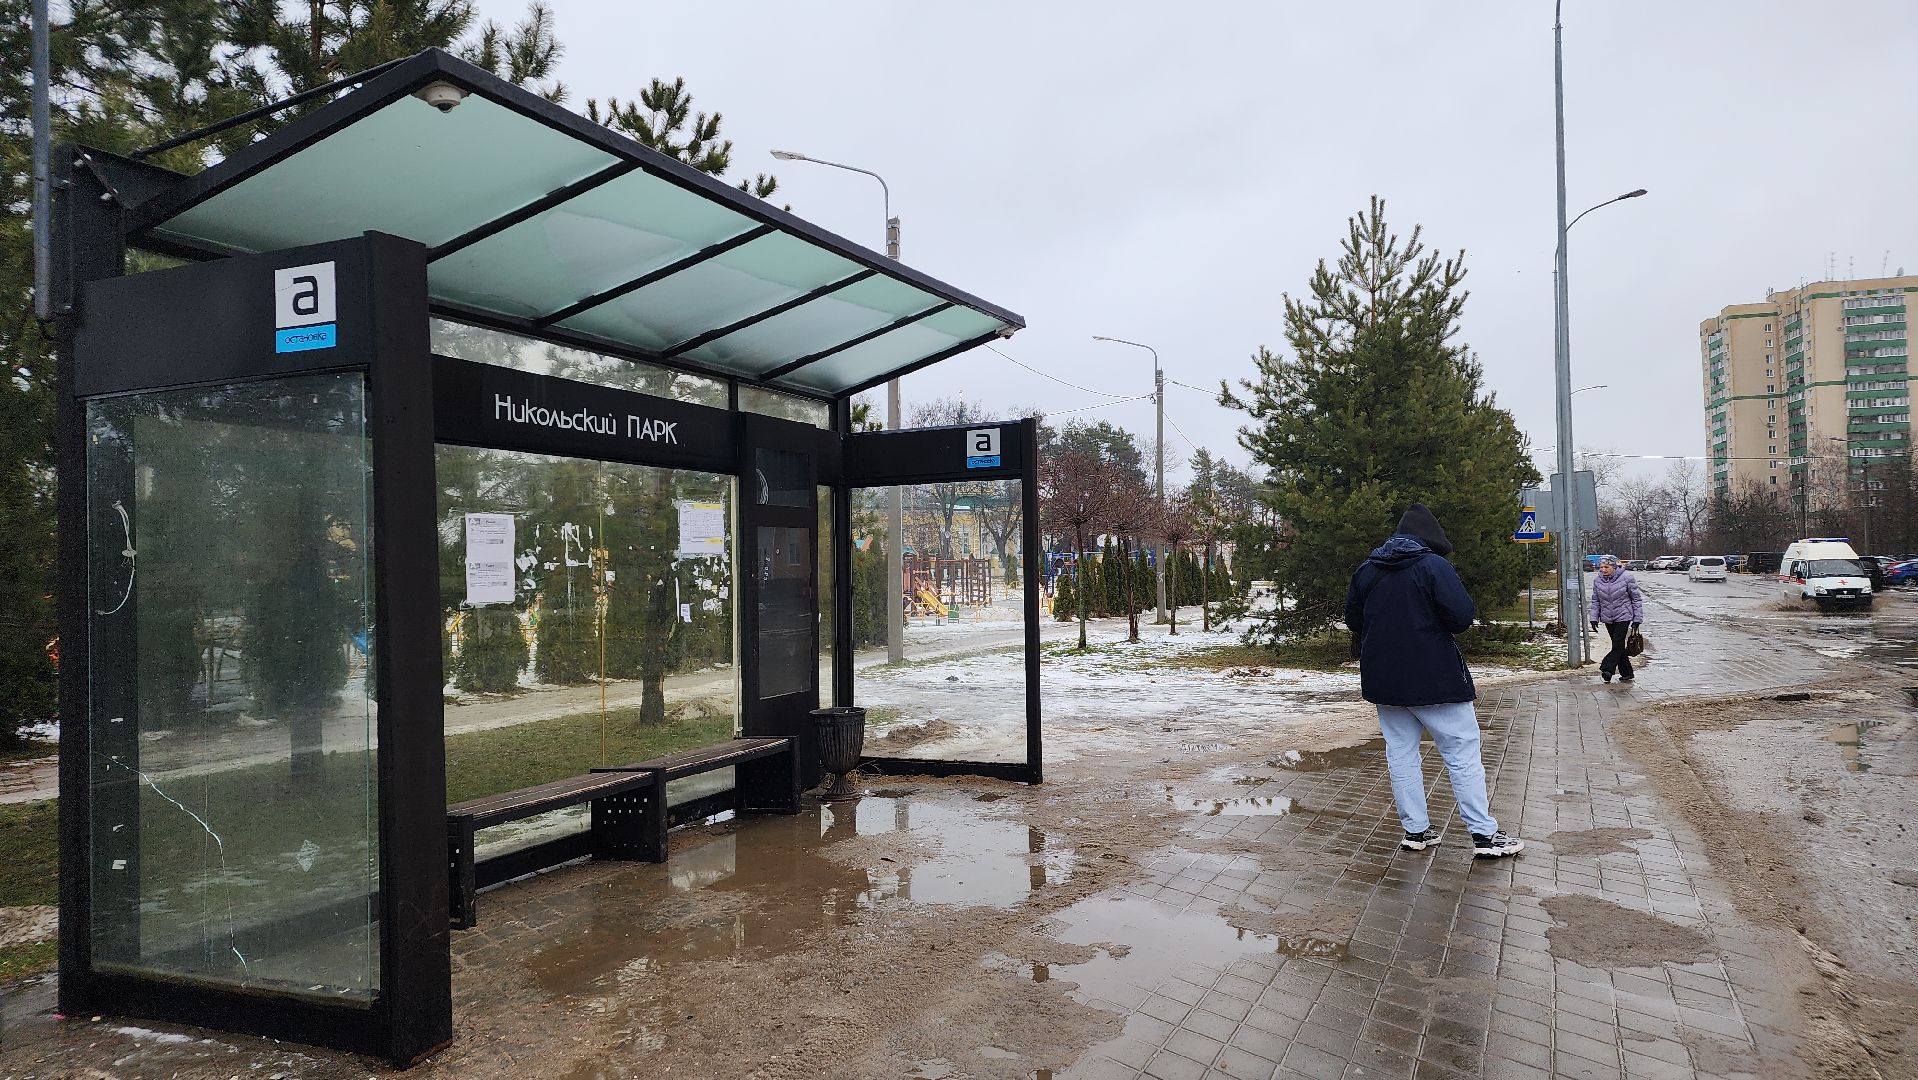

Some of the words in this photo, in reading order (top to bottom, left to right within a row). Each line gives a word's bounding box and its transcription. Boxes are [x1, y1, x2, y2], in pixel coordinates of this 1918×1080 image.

[292, 275, 319, 316] а
[284, 331, 327, 344] остановка
[494, 393, 617, 436] Никольский
[627, 414, 678, 445] ПАРК
[976, 433, 991, 451] а
